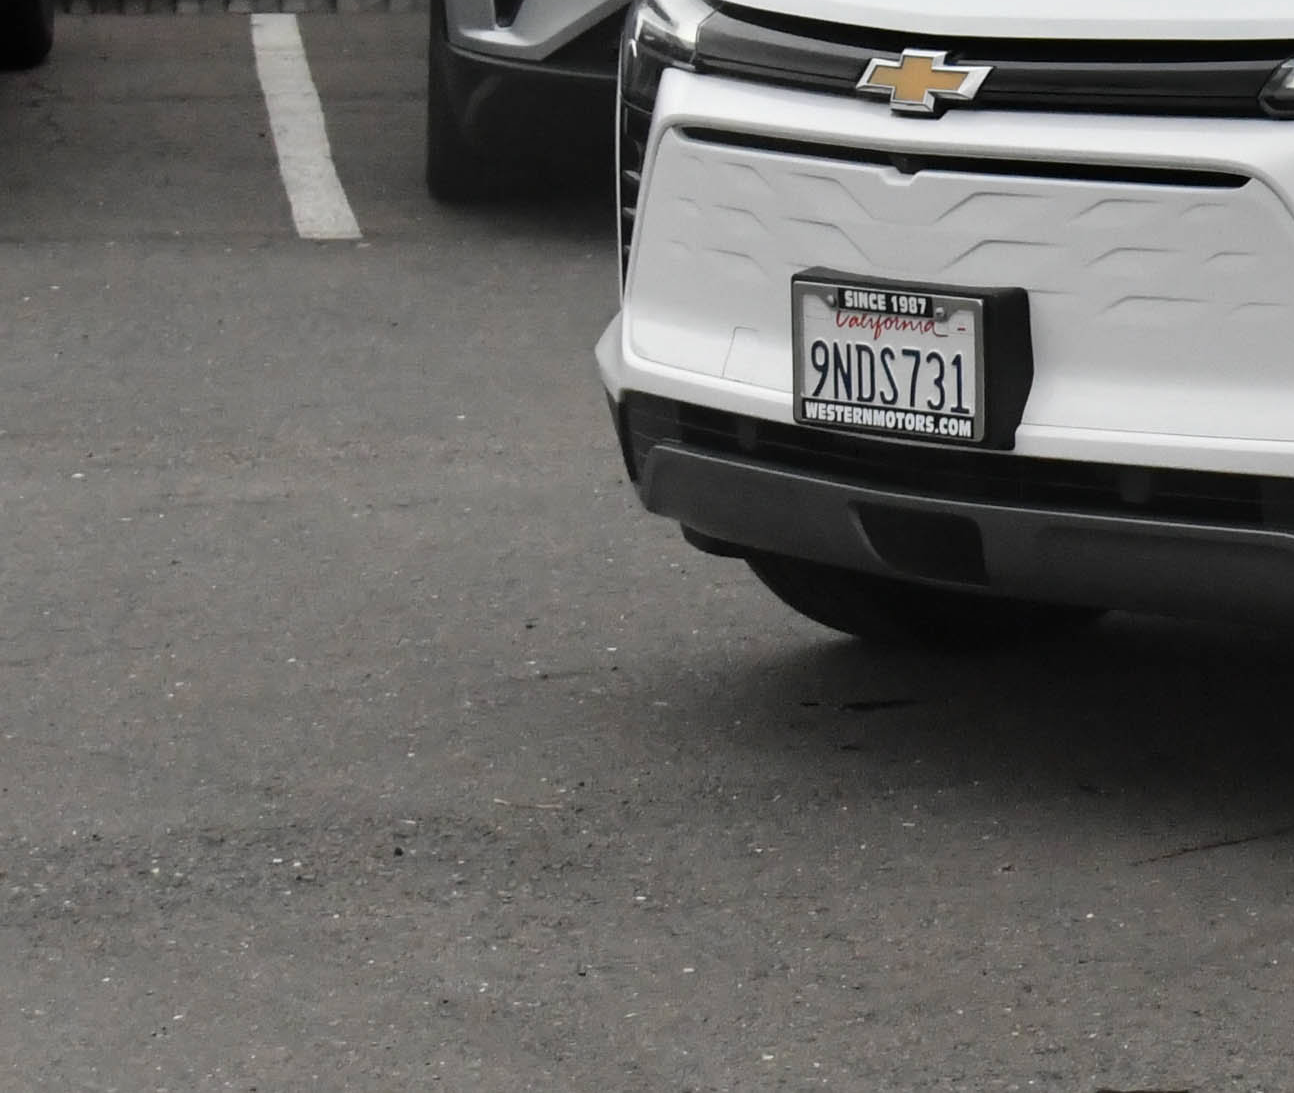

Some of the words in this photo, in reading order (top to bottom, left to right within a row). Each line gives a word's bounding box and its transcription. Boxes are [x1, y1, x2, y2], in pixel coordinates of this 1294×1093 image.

[844, 290, 887, 311] SINCE
[891, 295, 927, 315] 1987
[811, 340, 970, 414] 9NDS731
[805, 401, 972, 437] WESTERNMOTORS.COM
